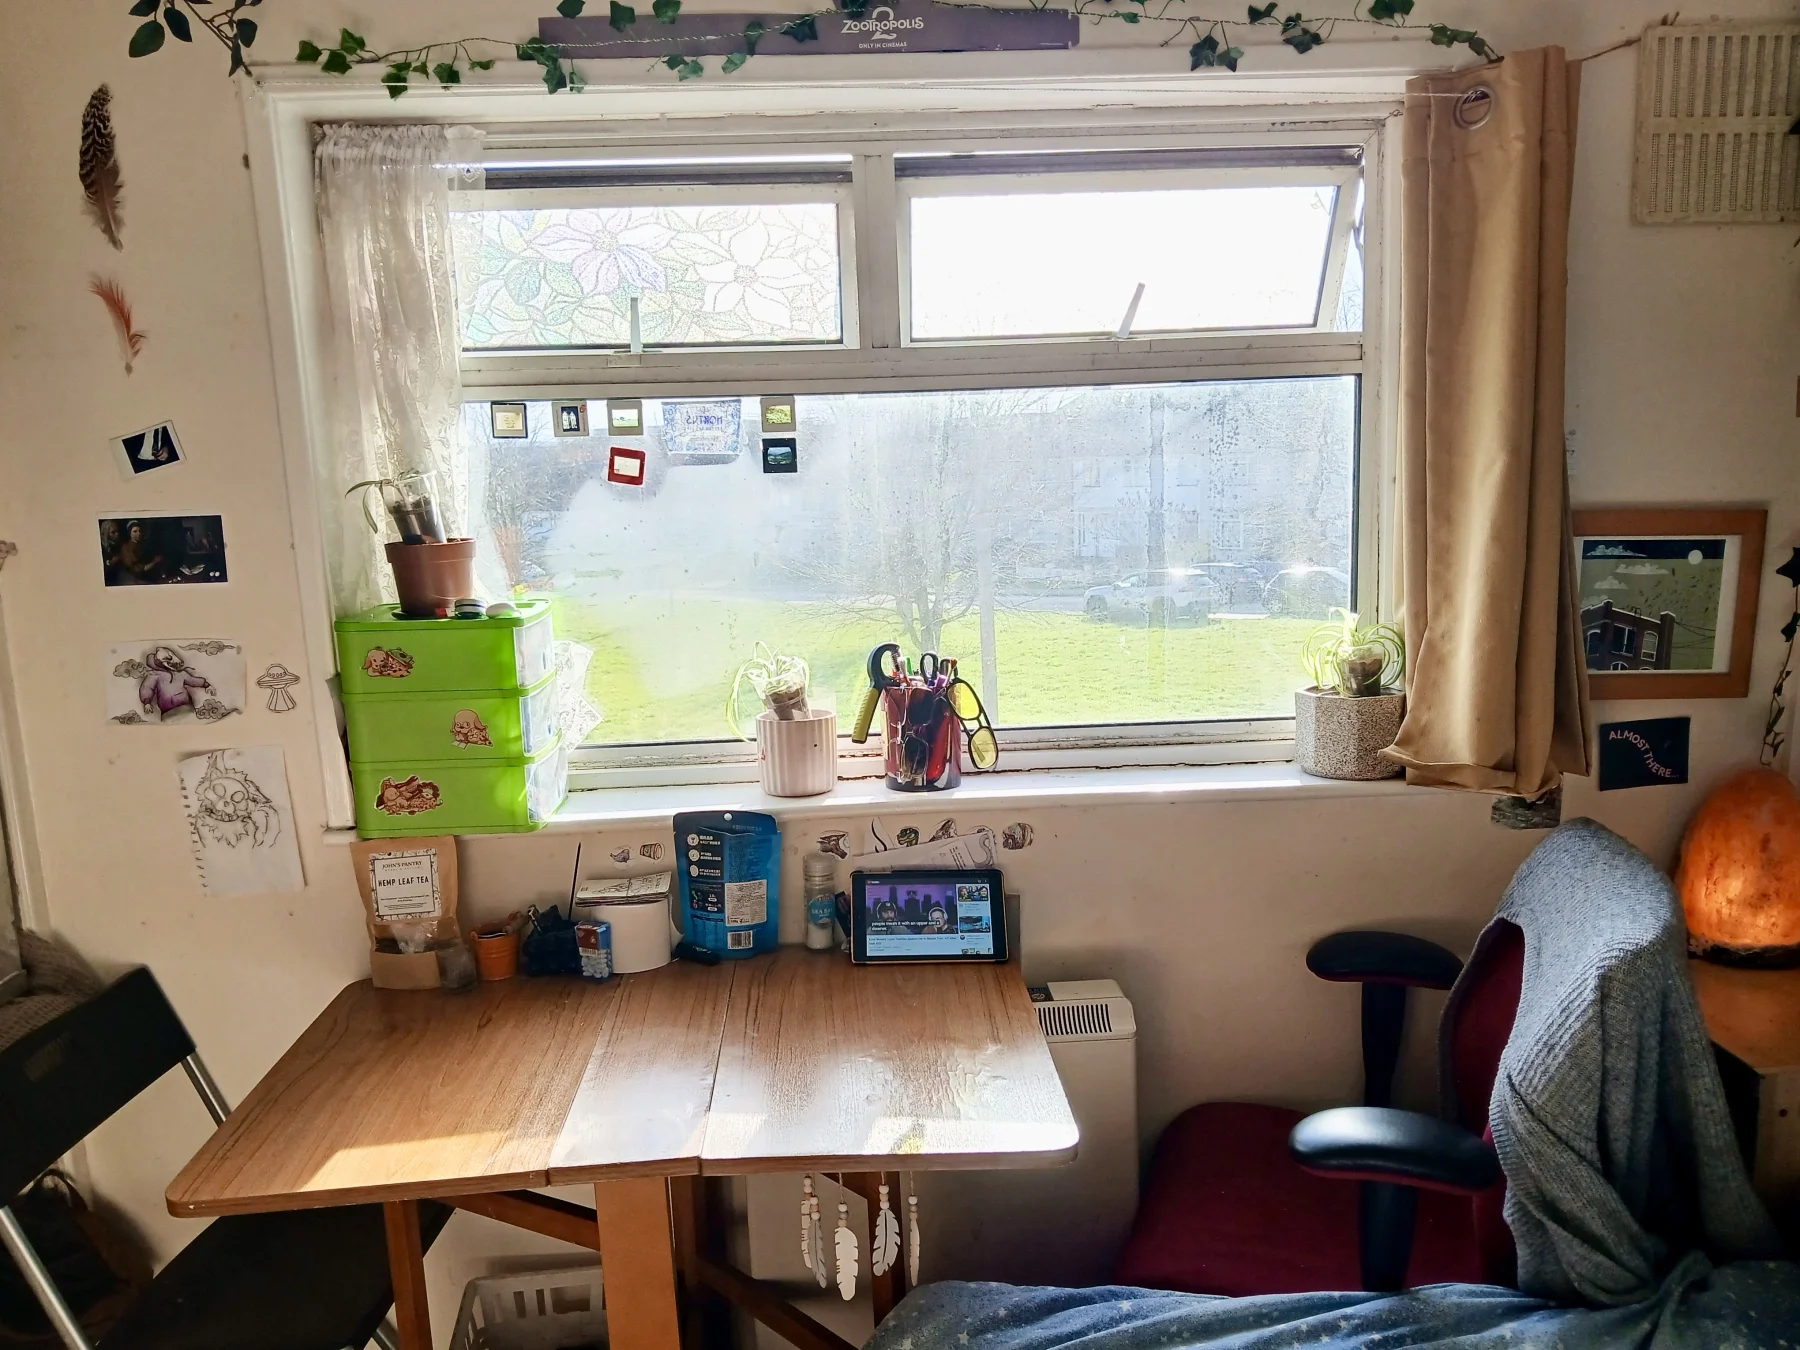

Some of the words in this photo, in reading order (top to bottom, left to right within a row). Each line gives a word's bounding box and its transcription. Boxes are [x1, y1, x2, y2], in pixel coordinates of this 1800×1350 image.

[841, 17, 924, 33] ZOOTROPOLIS
[1609, 730, 1650, 751] ALMOST
[378, 879, 396, 887] HEMP
[398, 877, 415, 885] LEAF
[417, 876, 429, 884] TEA
